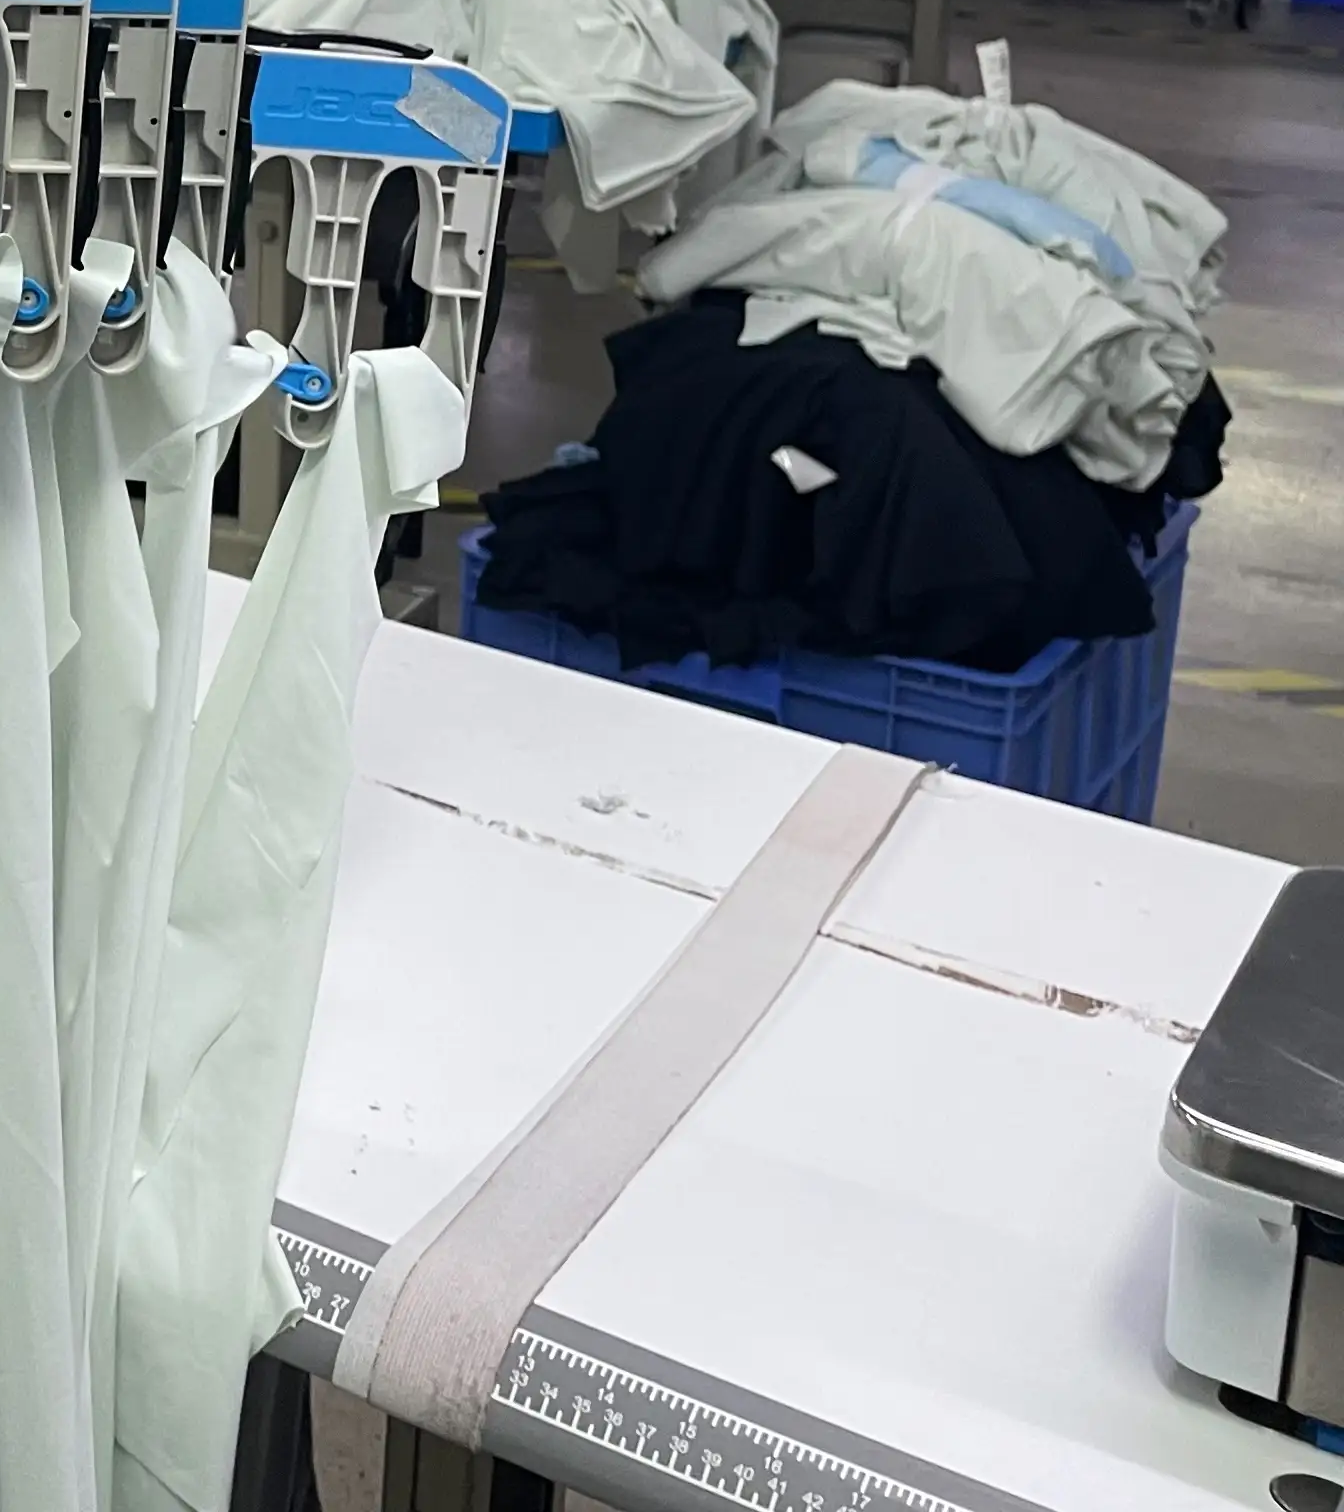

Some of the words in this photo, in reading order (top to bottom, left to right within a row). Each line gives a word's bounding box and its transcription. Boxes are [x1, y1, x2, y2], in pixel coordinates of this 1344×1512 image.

[265, 86, 410, 129] JAC
[294, 1261, 310, 1277] 10
[517, 1355, 535, 1372] 13
[598, 1388, 614, 1405] 14
[679, 1421, 698, 1439] 15
[764, 1456, 784, 1475] 16
[852, 1491, 871, 1509] 17
[303, 1281, 322, 1300] 26
[330, 1293, 351, 1310] 27
[509, 1369, 530, 1387] 33
[540, 1381, 559, 1400] 34
[572, 1395, 592, 1413] 35
[603, 1408, 624, 1427] 36
[635, 1421, 657, 1439] 37
[669, 1436, 689, 1454] 38
[701, 1448, 723, 1467] 39
[733, 1463, 755, 1481] 40
[767, 1477, 788, 1495] 41
[801, 1491, 825, 1510] 42
